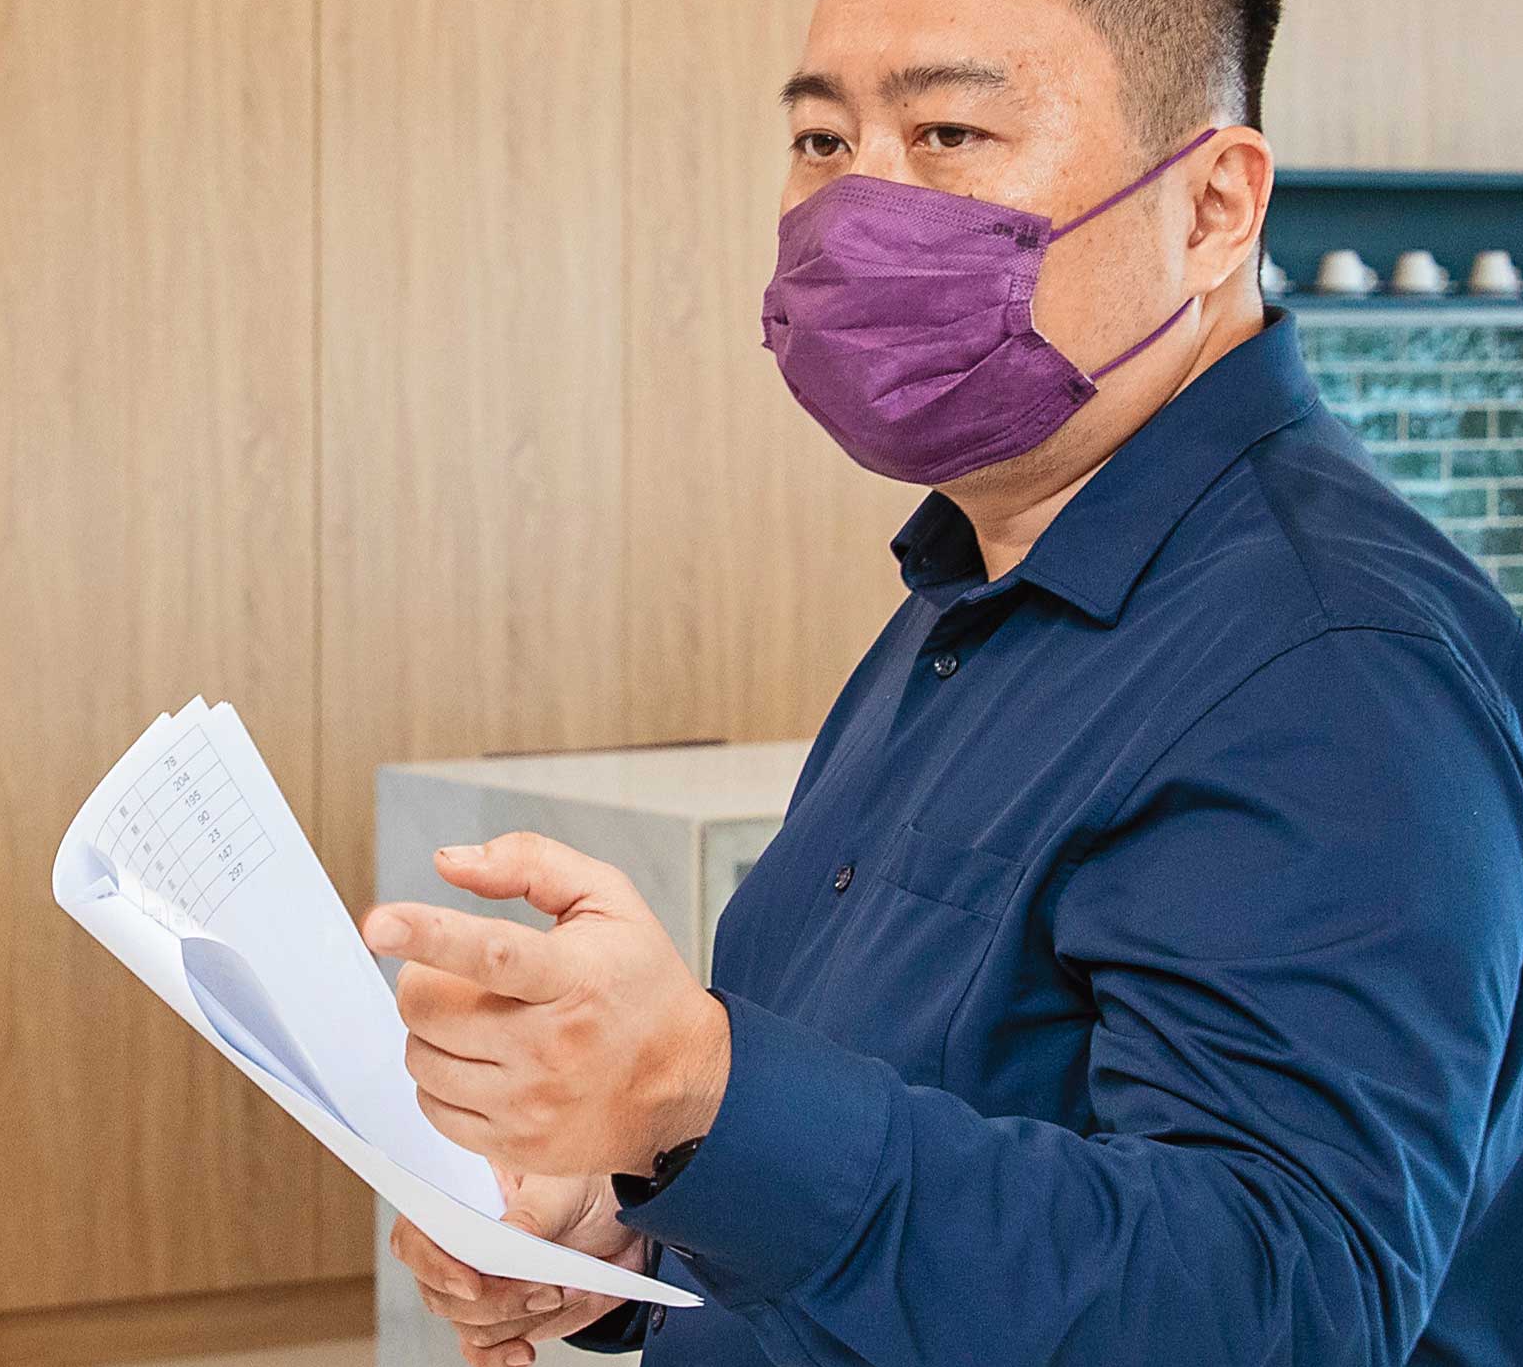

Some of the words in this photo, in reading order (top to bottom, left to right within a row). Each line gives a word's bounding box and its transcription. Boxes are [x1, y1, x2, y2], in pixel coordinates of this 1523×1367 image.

[172, 771, 191, 792] 204
[184, 789, 202, 808] 195
[197, 809, 211, 826] 90
[207, 828, 221, 844] 23
[218, 844, 234, 862] 147
[228, 862, 244, 882] 297
